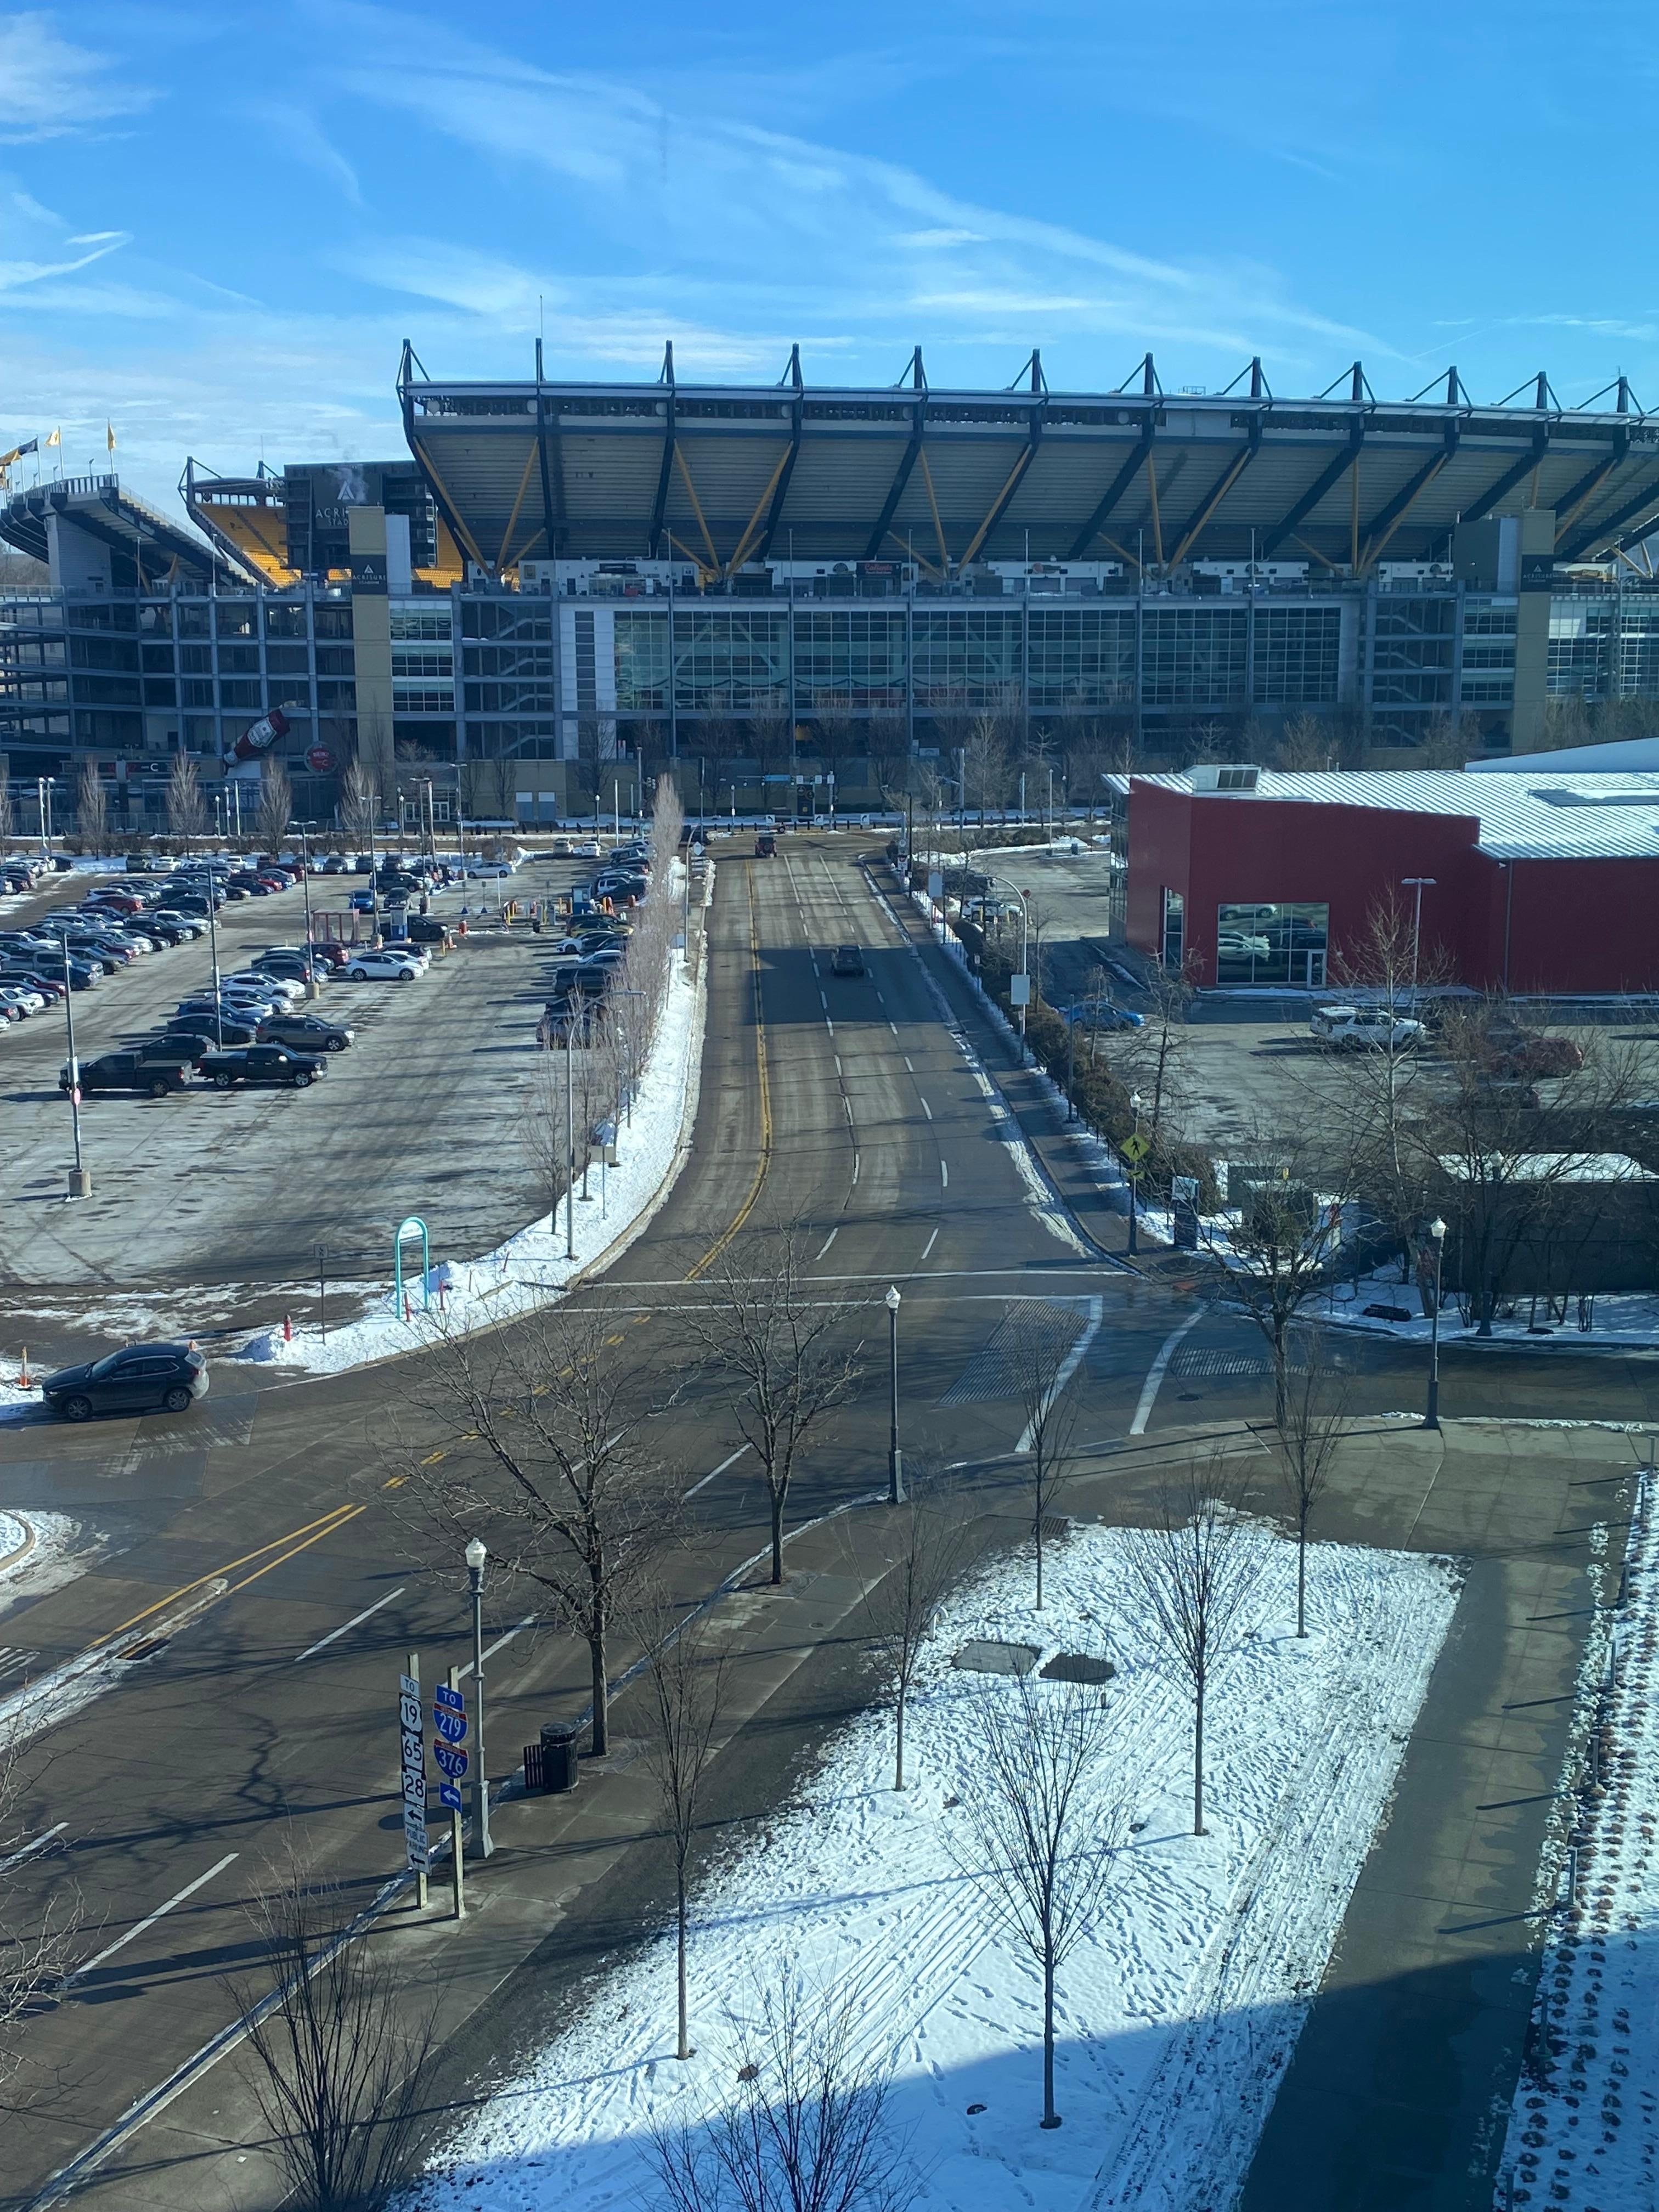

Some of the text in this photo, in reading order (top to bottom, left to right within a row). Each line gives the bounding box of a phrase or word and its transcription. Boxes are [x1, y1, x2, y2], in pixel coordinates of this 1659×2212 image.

[315, 507, 347, 518] ACRI
[404, 1678, 415, 1692] TO
[443, 1691, 456, 1705] TO
[404, 1702, 417, 1724] 19
[439, 1712, 461, 1737] 279
[404, 1739, 422, 1762] 65
[438, 1750, 463, 1775] 376
[405, 1775, 424, 1798] 28
[407, 1828, 426, 1844] PUBLIC
